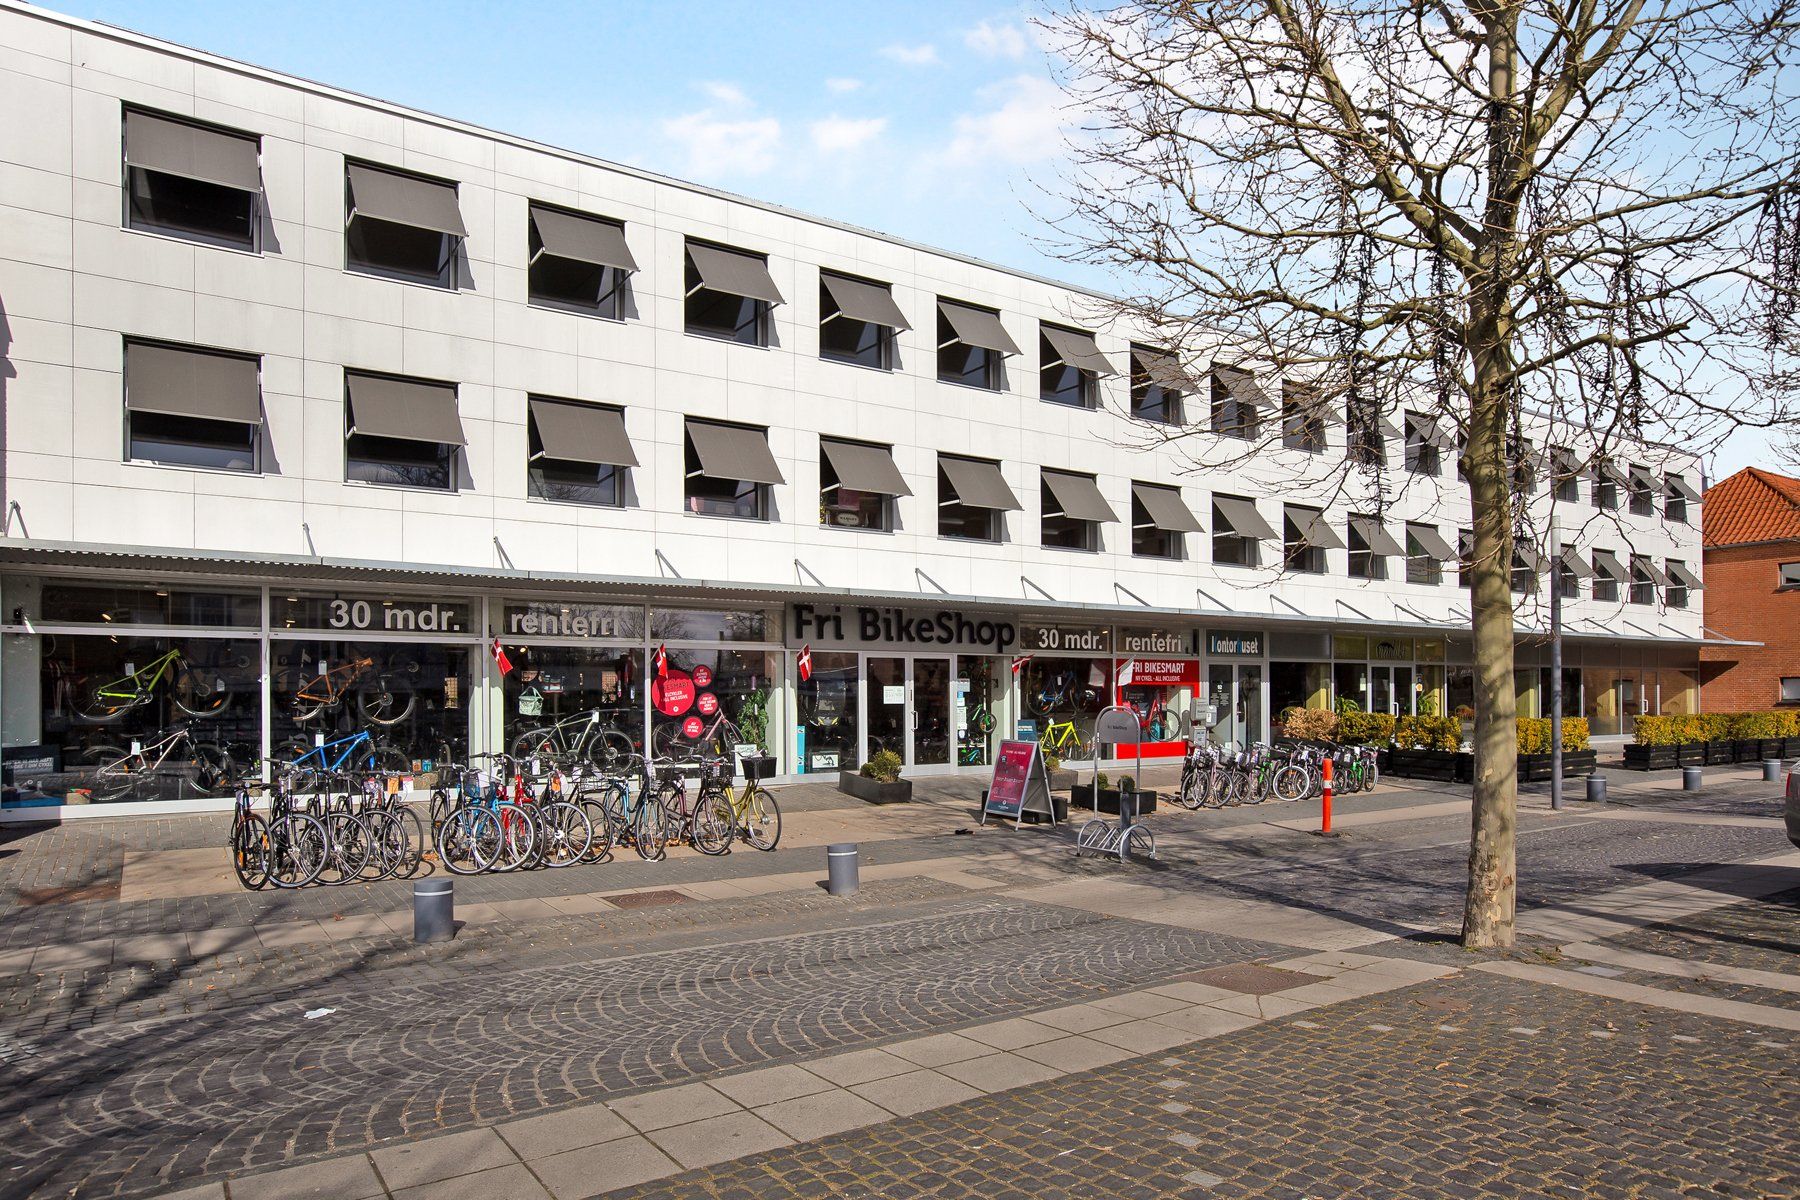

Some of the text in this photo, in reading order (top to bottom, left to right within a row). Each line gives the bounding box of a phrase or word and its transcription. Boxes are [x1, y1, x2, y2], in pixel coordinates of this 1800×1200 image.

[329, 600, 460, 631] 30 mdr.
[511, 609, 619, 636] rentefri
[793, 604, 1016, 654] Fri BikeShop
[1038, 628, 1103, 650] 30 mdr.
[1125, 634, 1182, 652] rentefri
[1144, 662, 1185, 674] BIKESMART
